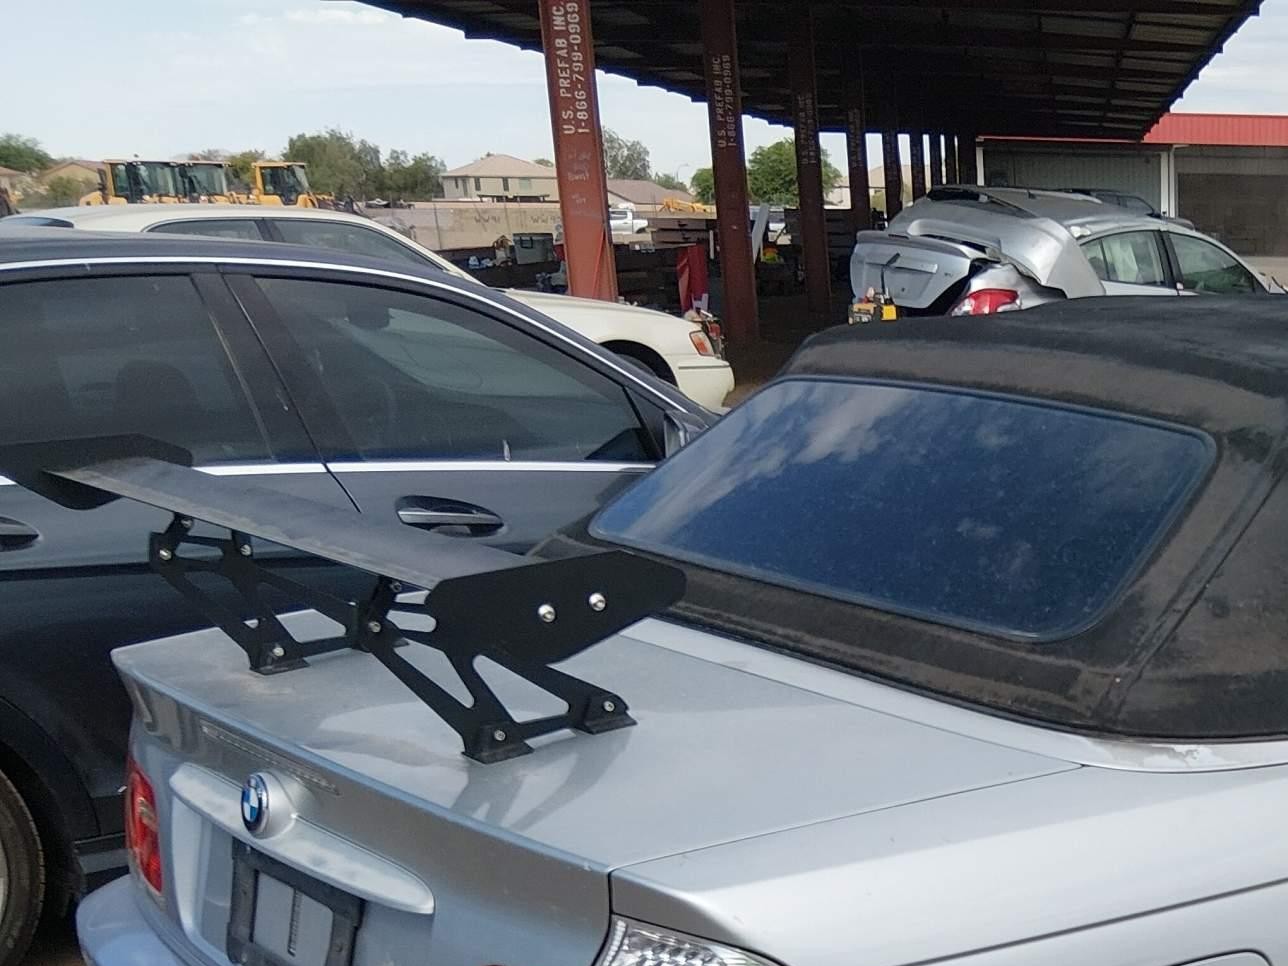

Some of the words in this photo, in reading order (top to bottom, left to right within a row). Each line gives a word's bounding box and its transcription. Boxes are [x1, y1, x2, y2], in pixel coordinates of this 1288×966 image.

[555, 38, 571, 97] PREFAB
[566, 2, 590, 133] 1-866-799-0969
[562, 107, 576, 134] U.S.
[713, 80, 725, 121] PREFAB
